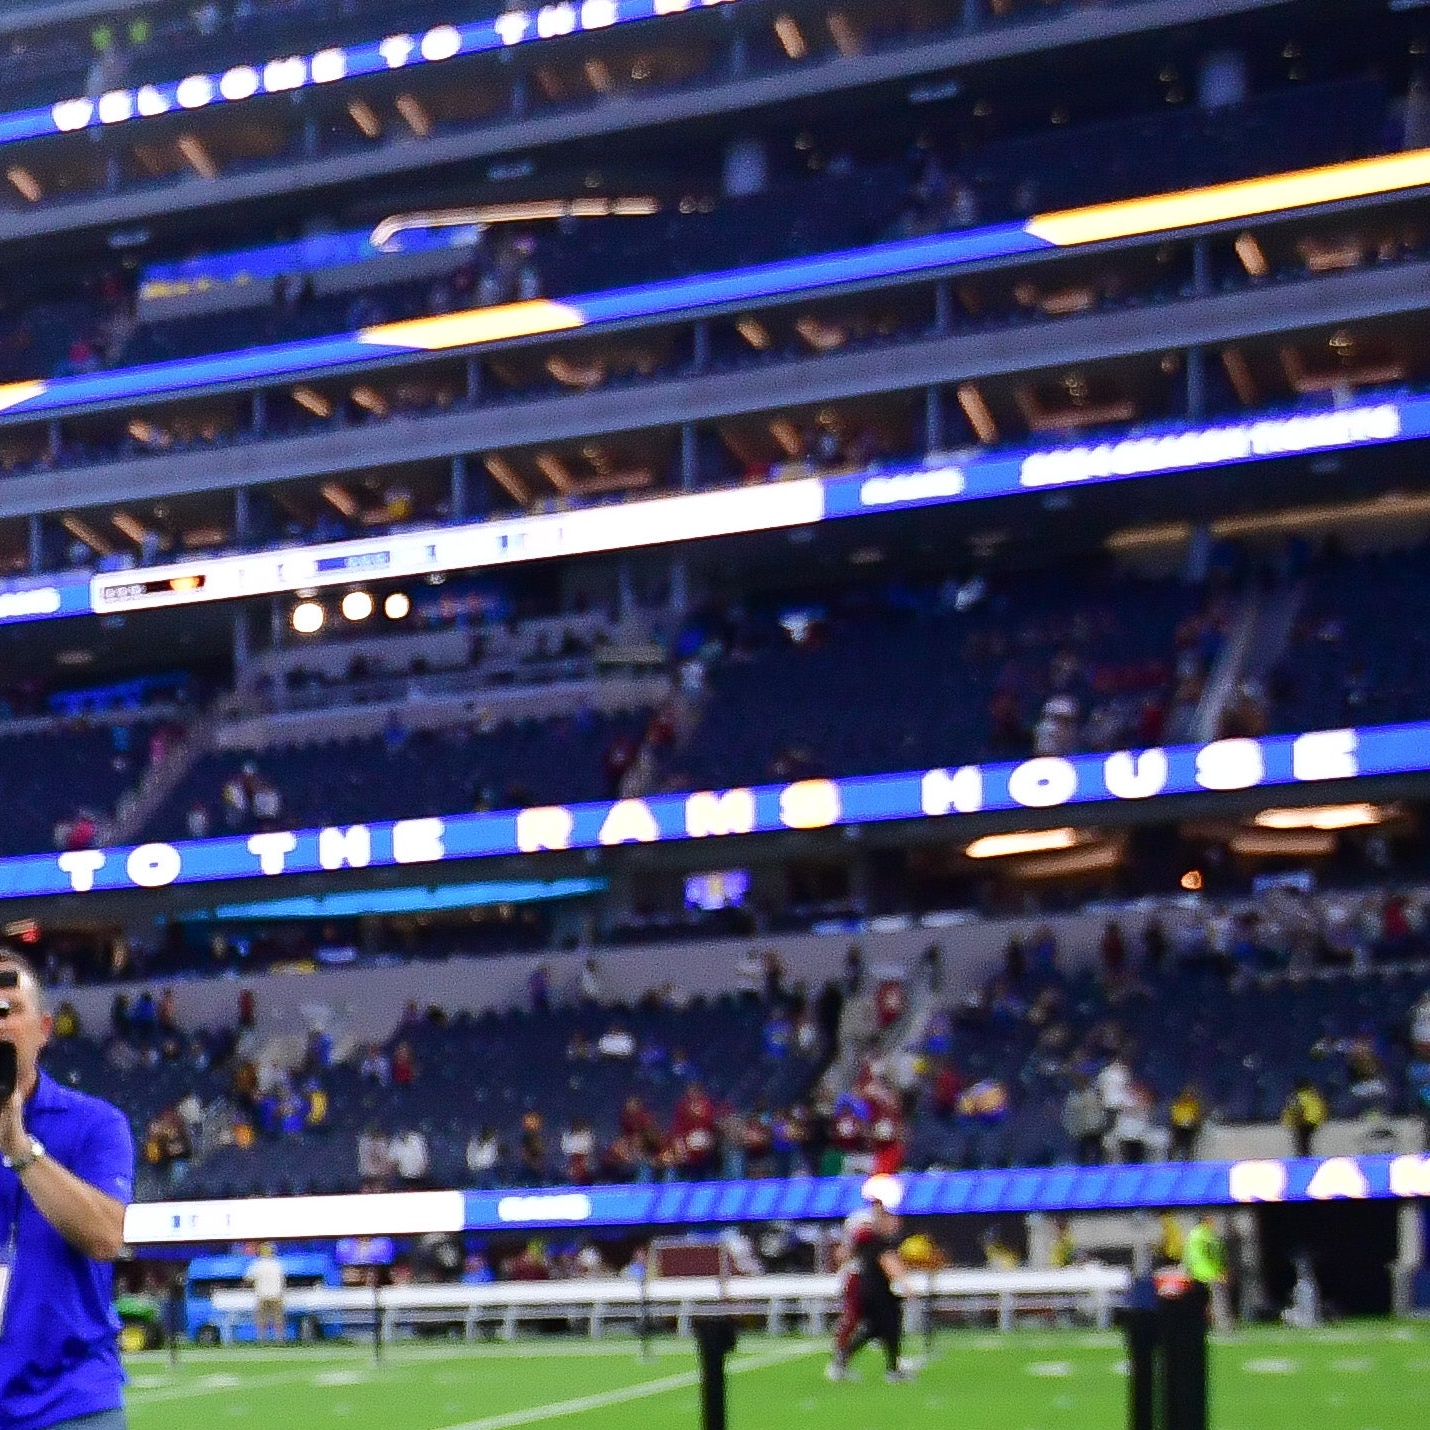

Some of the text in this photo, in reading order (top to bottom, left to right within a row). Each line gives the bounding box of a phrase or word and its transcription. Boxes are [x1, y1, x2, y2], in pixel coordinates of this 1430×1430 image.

[57, 842, 182, 892] TO
[247, 817, 444, 875] THE
[516, 779, 840, 852] RAMS
[921, 728, 1359, 816] HOUSE
